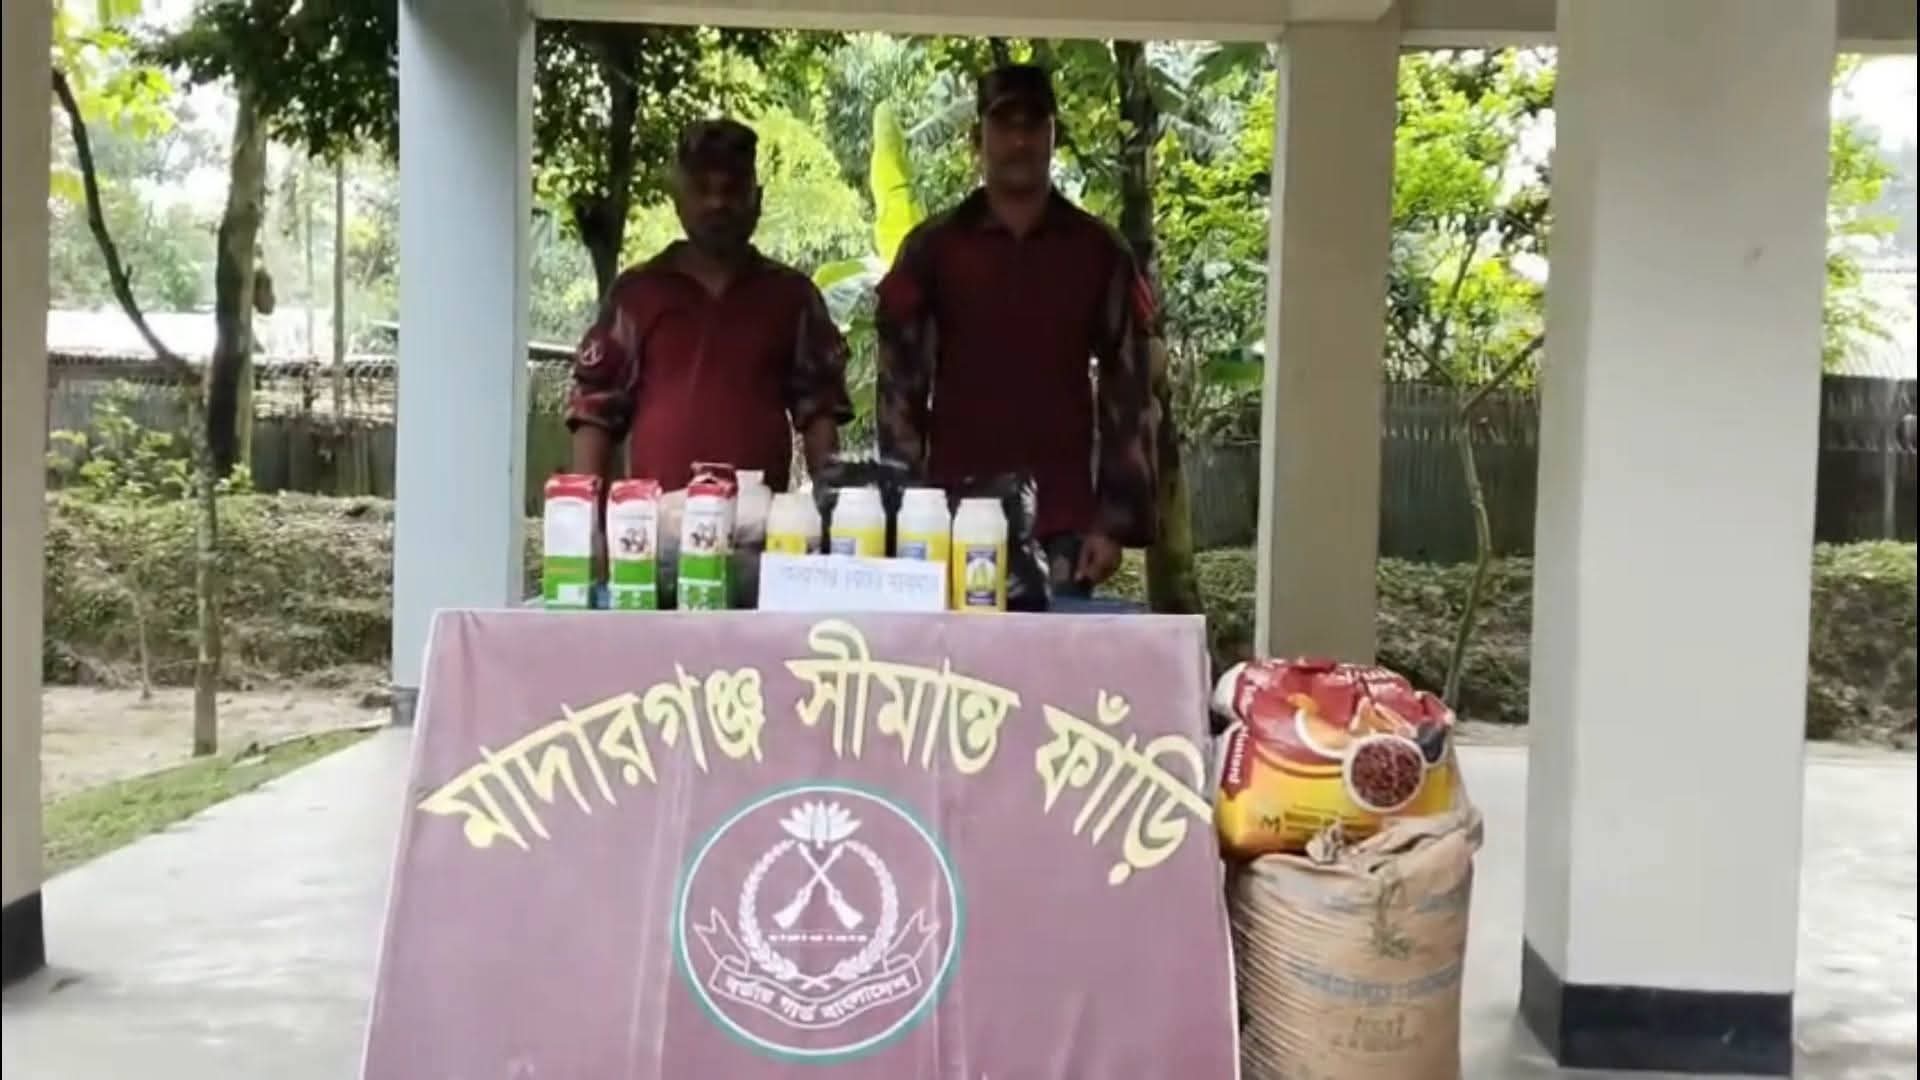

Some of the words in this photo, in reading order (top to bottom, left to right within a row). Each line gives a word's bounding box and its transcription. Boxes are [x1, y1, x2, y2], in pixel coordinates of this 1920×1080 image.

[415, 660, 765, 850] মাদারগঞ্জ
[784, 618, 1021, 774] সীমান্ত
[1036, 688, 1215, 886] ফাঁড়ি
